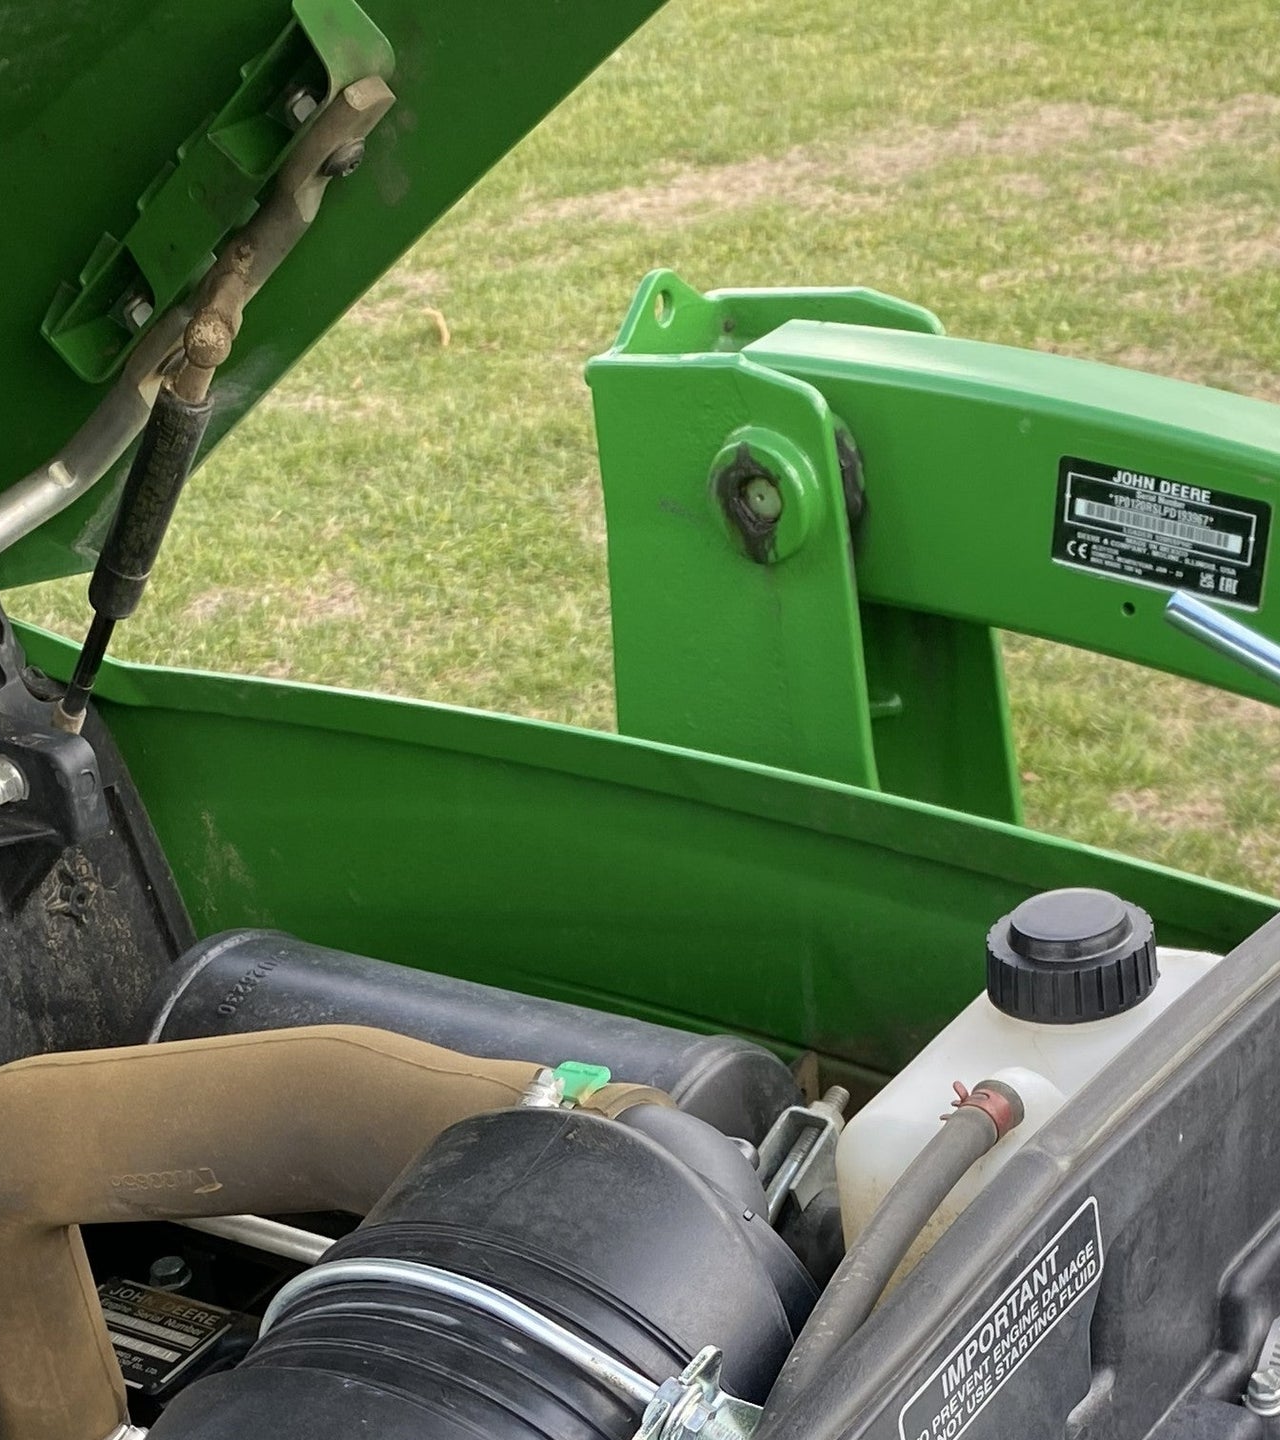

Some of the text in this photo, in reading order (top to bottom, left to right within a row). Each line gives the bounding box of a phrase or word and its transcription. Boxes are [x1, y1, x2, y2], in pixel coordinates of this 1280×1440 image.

[1112, 469, 1211, 503] JOHN DEERE
[134, 1309, 164, 1322] Serial
[164, 1318, 205, 1336] Number
[160, 1301, 221, 1326] DEERE
[932, 1357, 990, 1433] PREVENT
[993, 1301, 1039, 1367] ENGINE
[1042, 1240, 1095, 1307] DAMAGE
[941, 1246, 1059, 1398] IMPORTANT
[966, 1376, 993, 1414] USE
[995, 1305, 1057, 1383] STARTING
[1060, 1259, 1097, 1308] FLUID
